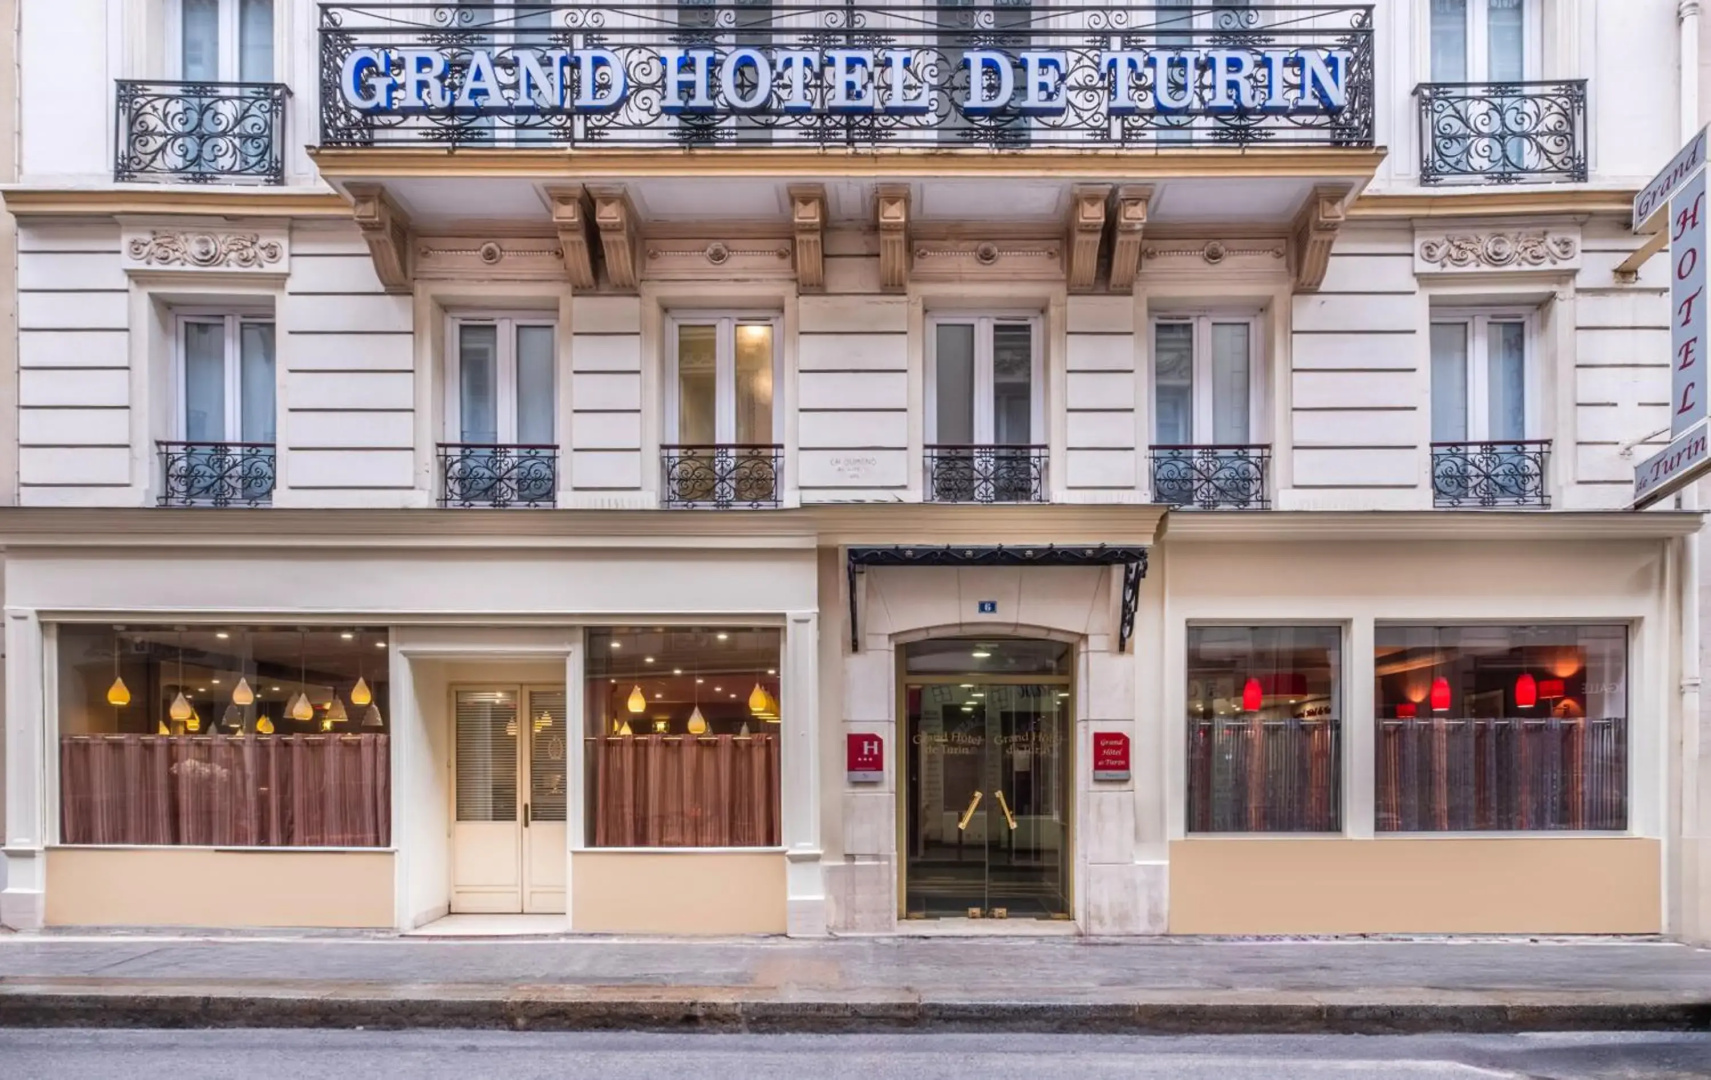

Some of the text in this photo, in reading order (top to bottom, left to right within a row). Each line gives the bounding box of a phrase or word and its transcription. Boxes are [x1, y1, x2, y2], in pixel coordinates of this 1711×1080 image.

[340, 48, 1351, 114] GRAND HOTEL DE TURIN
[1637, 133, 1704, 222] Grand
[1672, 191, 1705, 416] HOTEL
[1635, 434, 1708, 494] de Turin
[984, 602, 991, 611] 6
[863, 740, 879, 755] H
